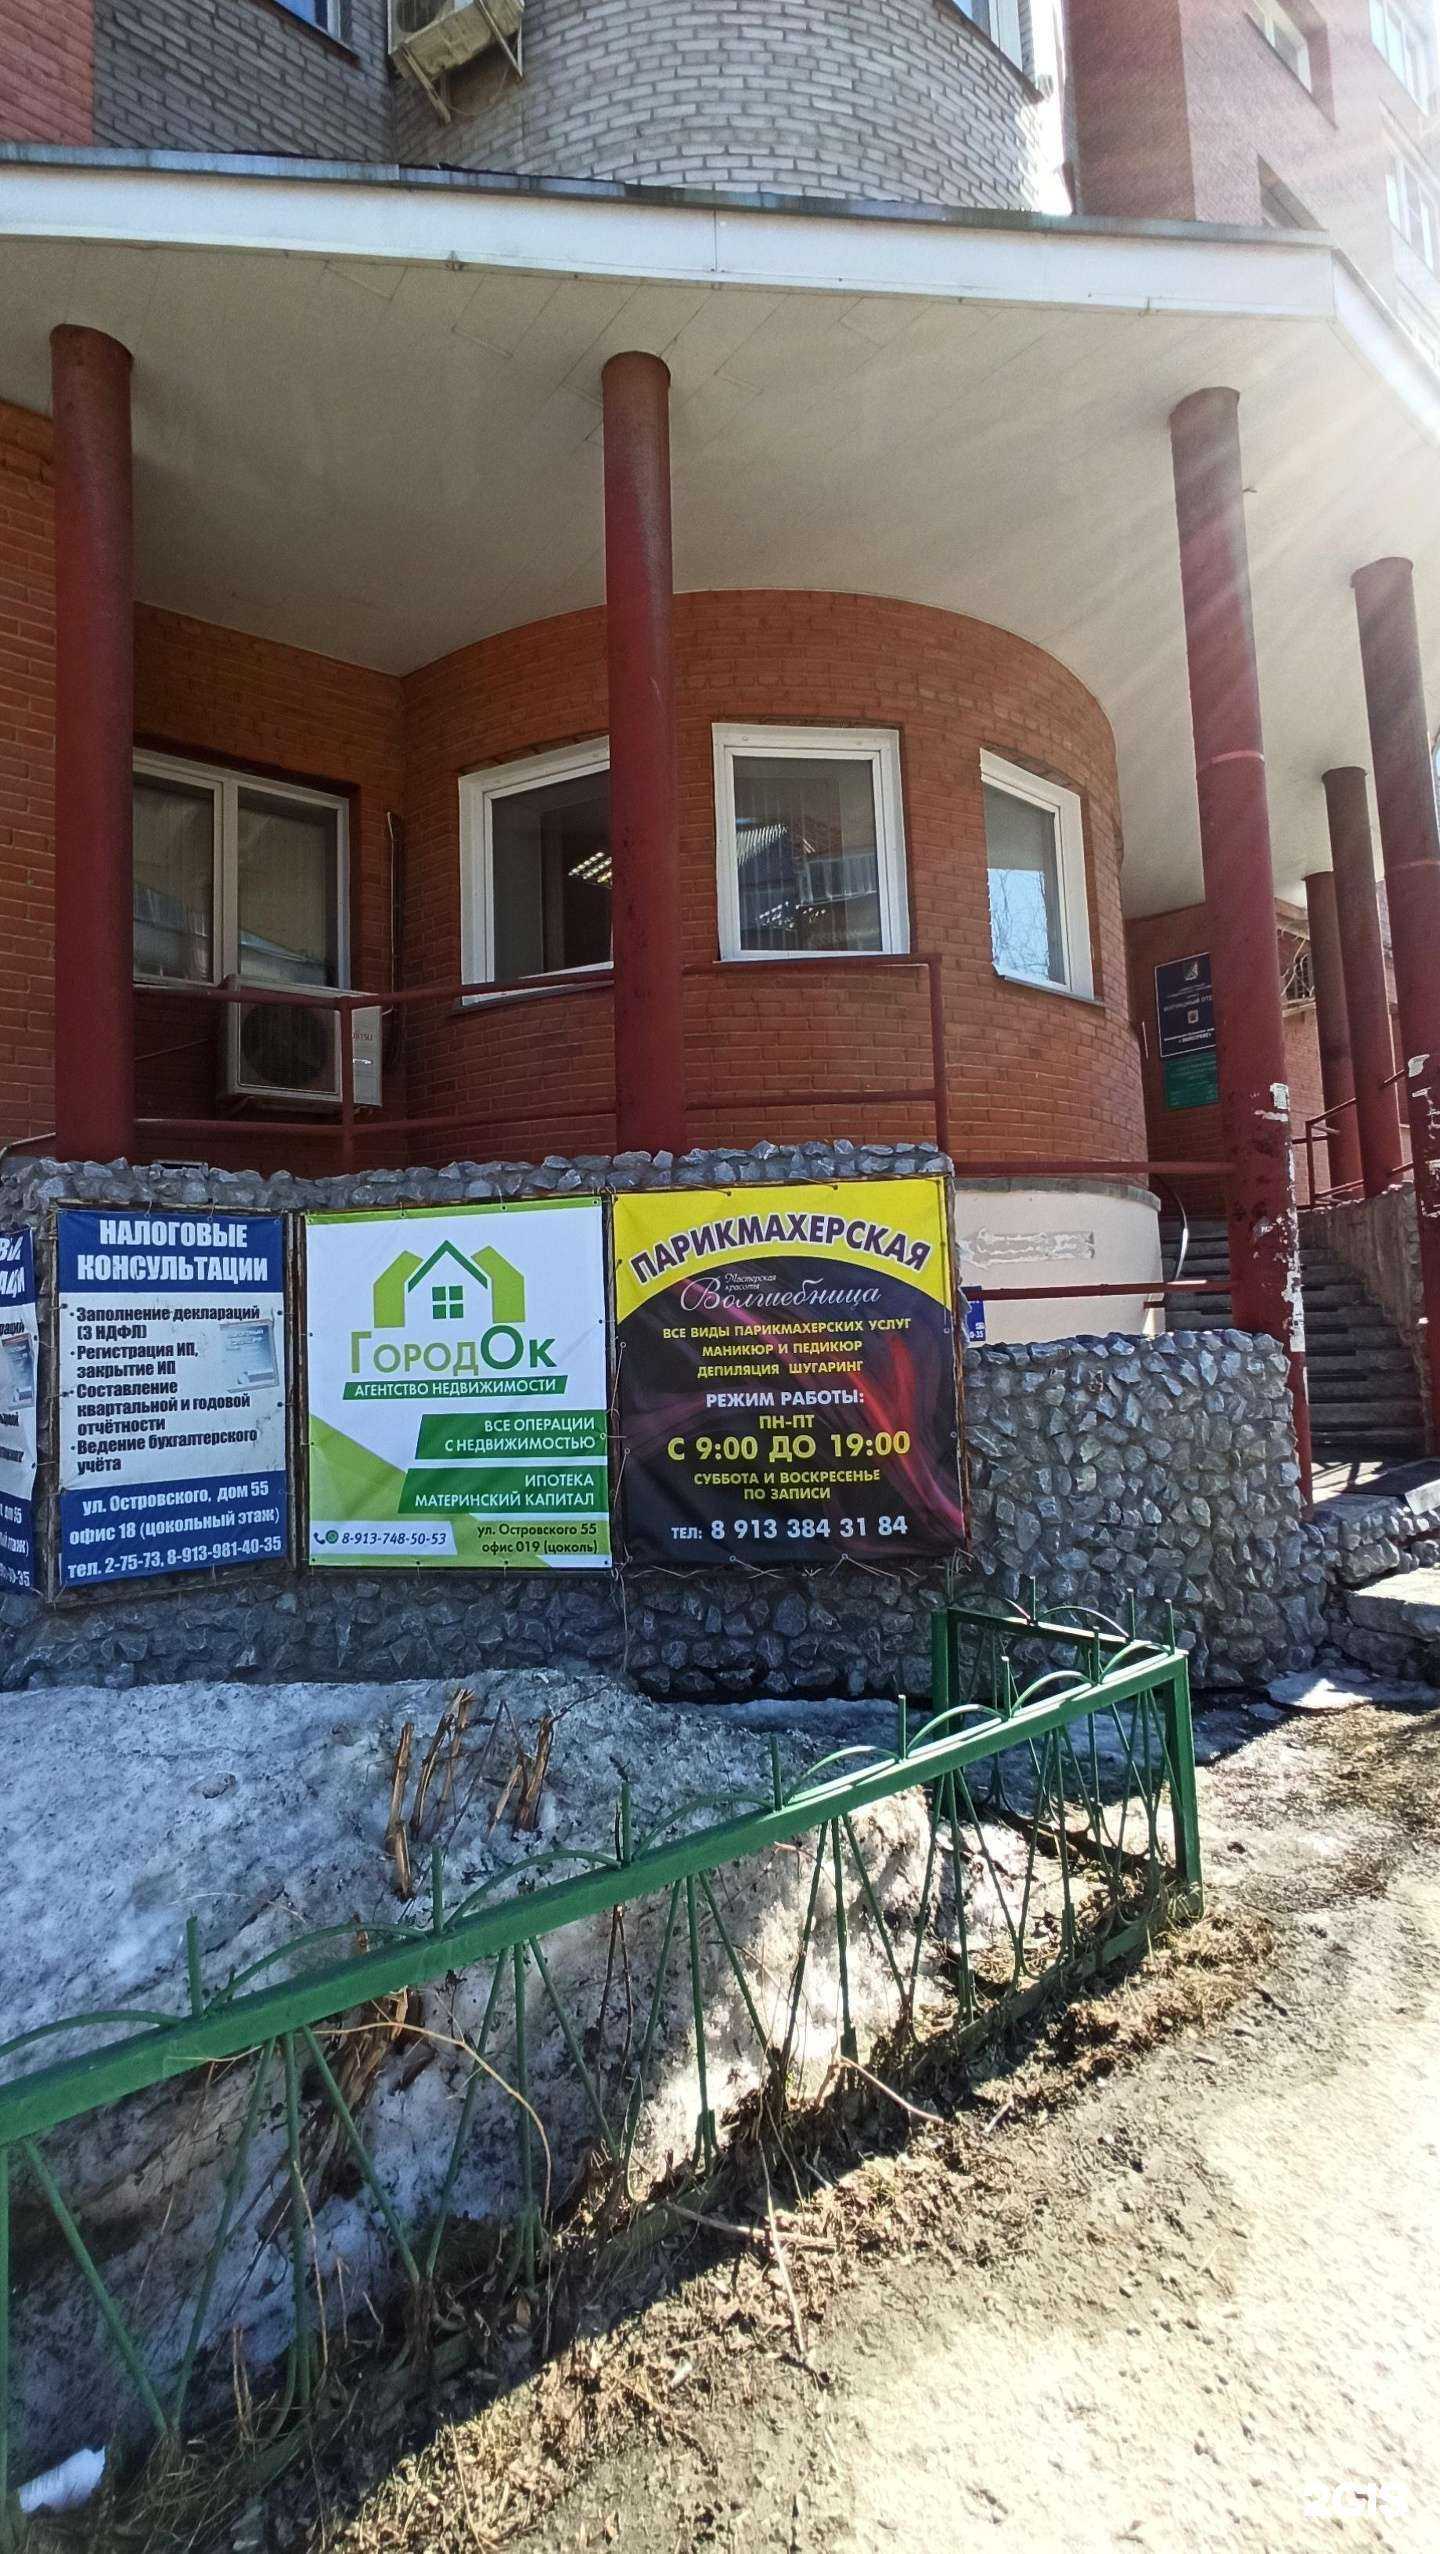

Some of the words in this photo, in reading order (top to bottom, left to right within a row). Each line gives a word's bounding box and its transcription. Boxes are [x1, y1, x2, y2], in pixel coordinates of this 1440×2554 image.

[100, 1219, 248, 1248] НАЛОГОВЫЕ
[631, 1213, 931, 1284] ПАРИКМАХЕРСКАЯ
[77, 1254, 268, 1285] КОНСУЛЬТАЦИИ
[680, 1277, 882, 1312] Волшебница
[76, 1306, 171, 1322] Заполнение
[172, 1305, 260, 1324] деклараций
[96, 1325, 147, 1342] НДФЛ)
[663, 1327, 687, 1340] ВСЕ
[690, 1325, 731, 1339] ВИДЫ
[734, 1320, 864, 1337] ПАРИКМАХЕРСКИХ
[868, 1317, 912, 1331] УСЛУГ
[77, 1343, 174, 1361] Регистрация
[176, 1342, 199, 1357] ИП,
[702, 1343, 774, 1358] МАНИКЮР
[778, 1343, 788, 1354] И
[793, 1340, 864, 1355] ПЕДИКЮР
[76, 1362, 155, 1379] закрытие
[157, 1361, 176, 1375] ИП
[697, 1363, 780, 1380] ДЕПИЛЯЦИЯ
[789, 1360, 864, 1375] ШУГАРИНГ
[76, 1381, 178, 1398] Составление
[354, 1383, 430, 1397] АГЕНТСТВО
[432, 1379, 557, 1396] НЕДВИЖИМОСТИ
[77, 1397, 178, 1418] квартальной
[181, 1399, 190, 1411] и
[192, 1393, 251, 1411] годовой
[706, 1392, 775, 1409] РЕЖИМ
[781, 1389, 865, 1407] РАБОТЫ:
[77, 1418, 166, 1436] отчётности
[484, 1420, 511, 1433] ВСЕ
[513, 1416, 596, 1433] ОПЕРАЦИИ
[759, 1414, 815, 1430] ПН-ПТ
[77, 1436, 146, 1455] Ведение
[149, 1429, 258, 1450] бухгалтерского
[444, 1439, 454, 1452] С
[456, 1436, 597, 1454] НЕДВИЖИМОСТЬЮ
[667, 1437, 686, 1461] С
[695, 1435, 759, 1461] 9:00
[768, 1434, 817, 1463] ДО
[830, 1430, 911, 1458] 19:00
[77, 1457, 122, 1475] учёта
[524, 1474, 595, 1488] ИПОТЕКА
[694, 1472, 760, 1486] СУББОТА
[763, 1472, 776, 1484] И
[780, 1469, 881, 1484] ВОСКРЕСЕНЬЕ
[82, 1501, 107, 1516] ул.
[217, 1484, 248, 1503] дом
[250, 1480, 269, 1496] 55
[414, 1490, 521, 1508] МАТЕРИНСКИЙ
[525, 1492, 595, 1507] КАПИТАЛ
[744, 1488, 766, 1501] ПО
[770, 1487, 832, 1500] ЗАПИСИ
[69, 1527, 116, 1546] офис
[118, 1522, 136, 1539] 18
[139, 1511, 236, 1540] (цокольный
[238, 1507, 280, 1525] этаж)
[477, 1527, 497, 1538] ул.
[498, 1523, 578, 1538] Островского
[580, 1522, 598, 1535] 55
[671, 1527, 703, 1540] ТЕЛ:
[711, 1519, 726, 1540] 8
[733, 1519, 778, 1539] 913
[786, 1518, 832, 1538] 384
[839, 1517, 868, 1537] 31
[878, 1515, 909, 1536] 84
[341, 1532, 448, 1546] 8-913-748-50-53
[481, 1541, 516, 1556] офис
[515, 1540, 541, 1553] 019
[543, 1538, 598, 1556] (цоколь)
[68, 1562, 102, 1578] тел.
[104, 1550, 165, 1573] 2-75-73,
[166, 1535, 282, 1565] 8-913-981-40-35
